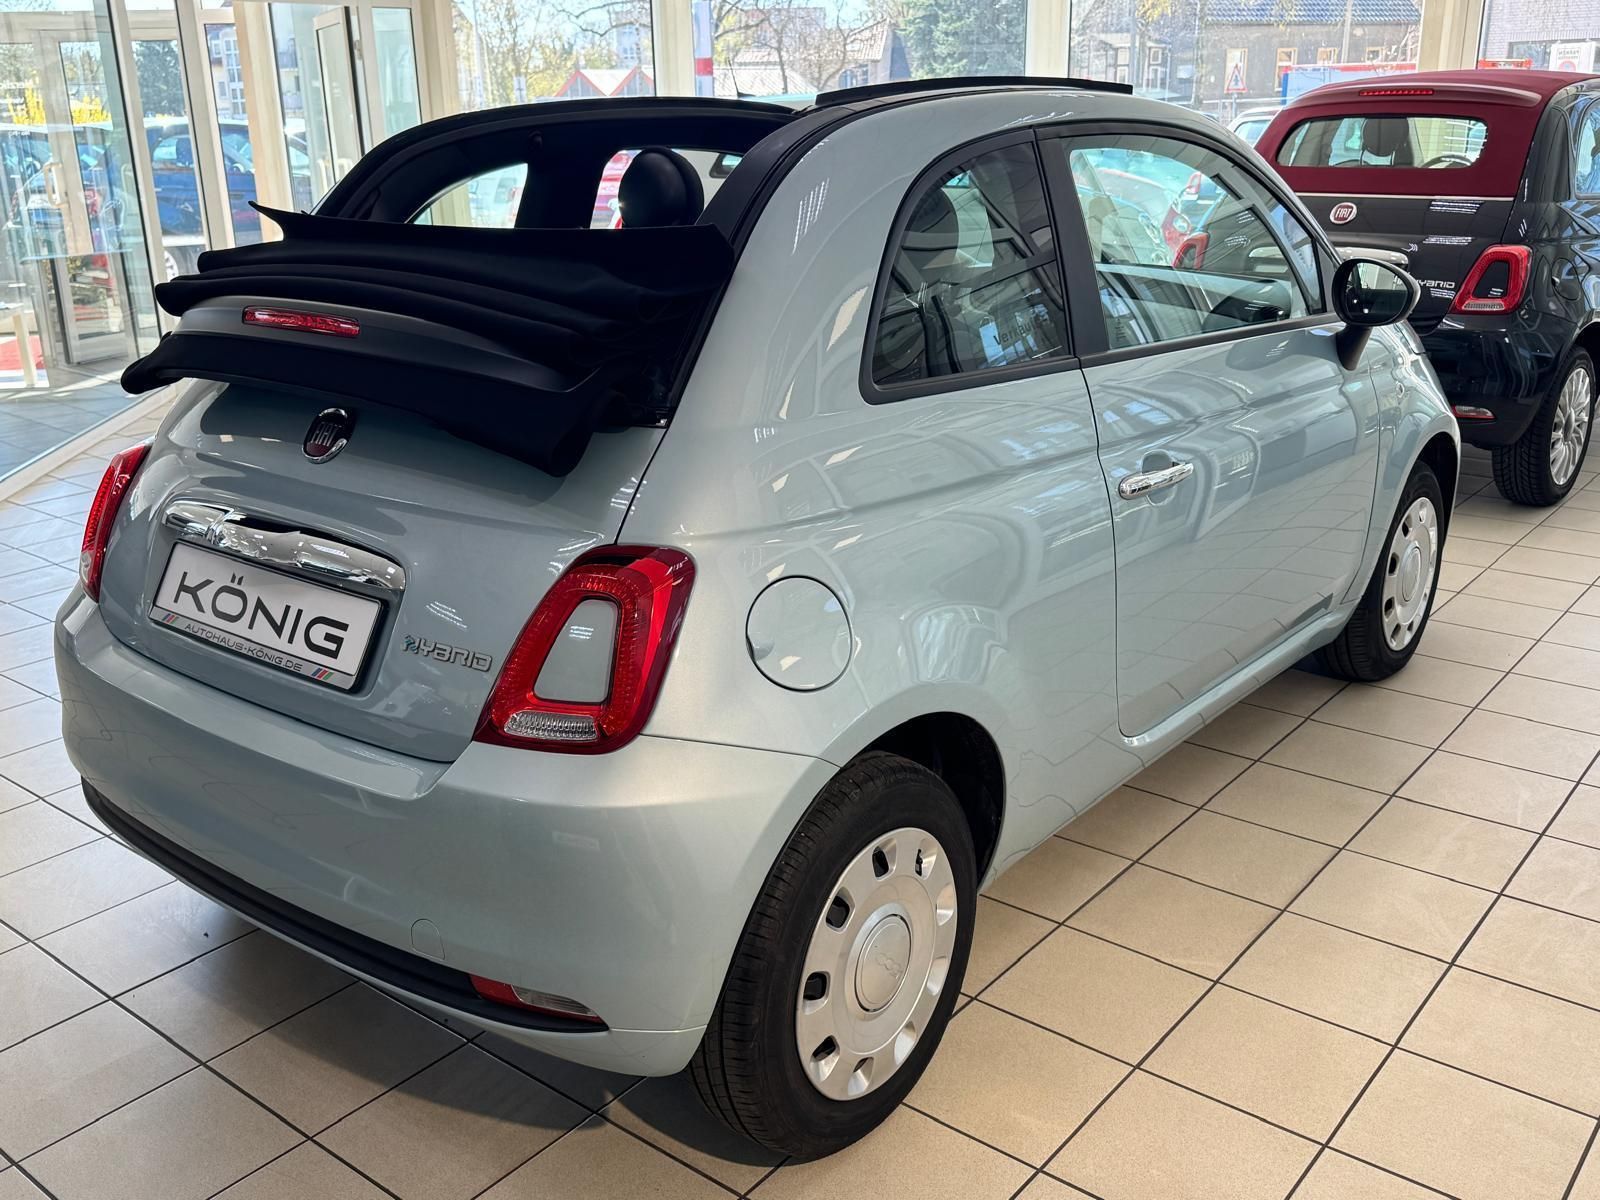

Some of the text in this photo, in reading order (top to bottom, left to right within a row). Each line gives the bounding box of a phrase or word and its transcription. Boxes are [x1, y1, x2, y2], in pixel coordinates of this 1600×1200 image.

[1335, 207, 1352, 219] FIAT
[311, 422, 342, 447] FIAT
[173, 571, 349, 660] KÖNIG
[402, 635, 493, 673] HYBRID
